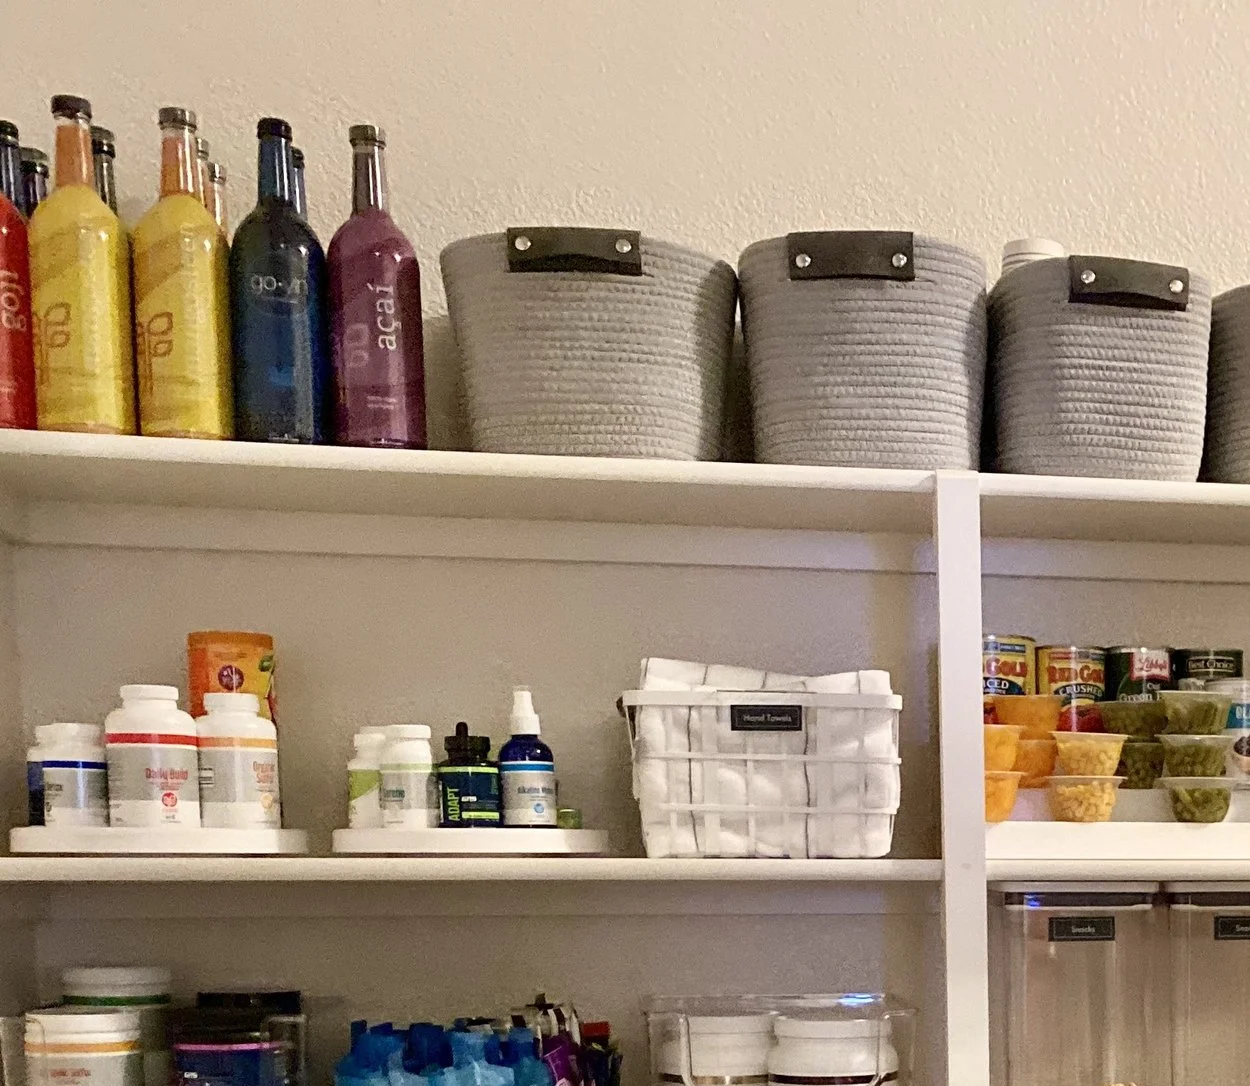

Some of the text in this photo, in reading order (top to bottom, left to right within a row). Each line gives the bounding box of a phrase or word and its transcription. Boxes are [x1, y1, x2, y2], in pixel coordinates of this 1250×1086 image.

[366, 282, 402, 350] açaí
[1206, 658, 1236, 670] Choice
[743, 714, 793, 722] Hand Towels
[145, 767, 189, 781] Daily Build
[447, 787, 460, 822] ADAPT
